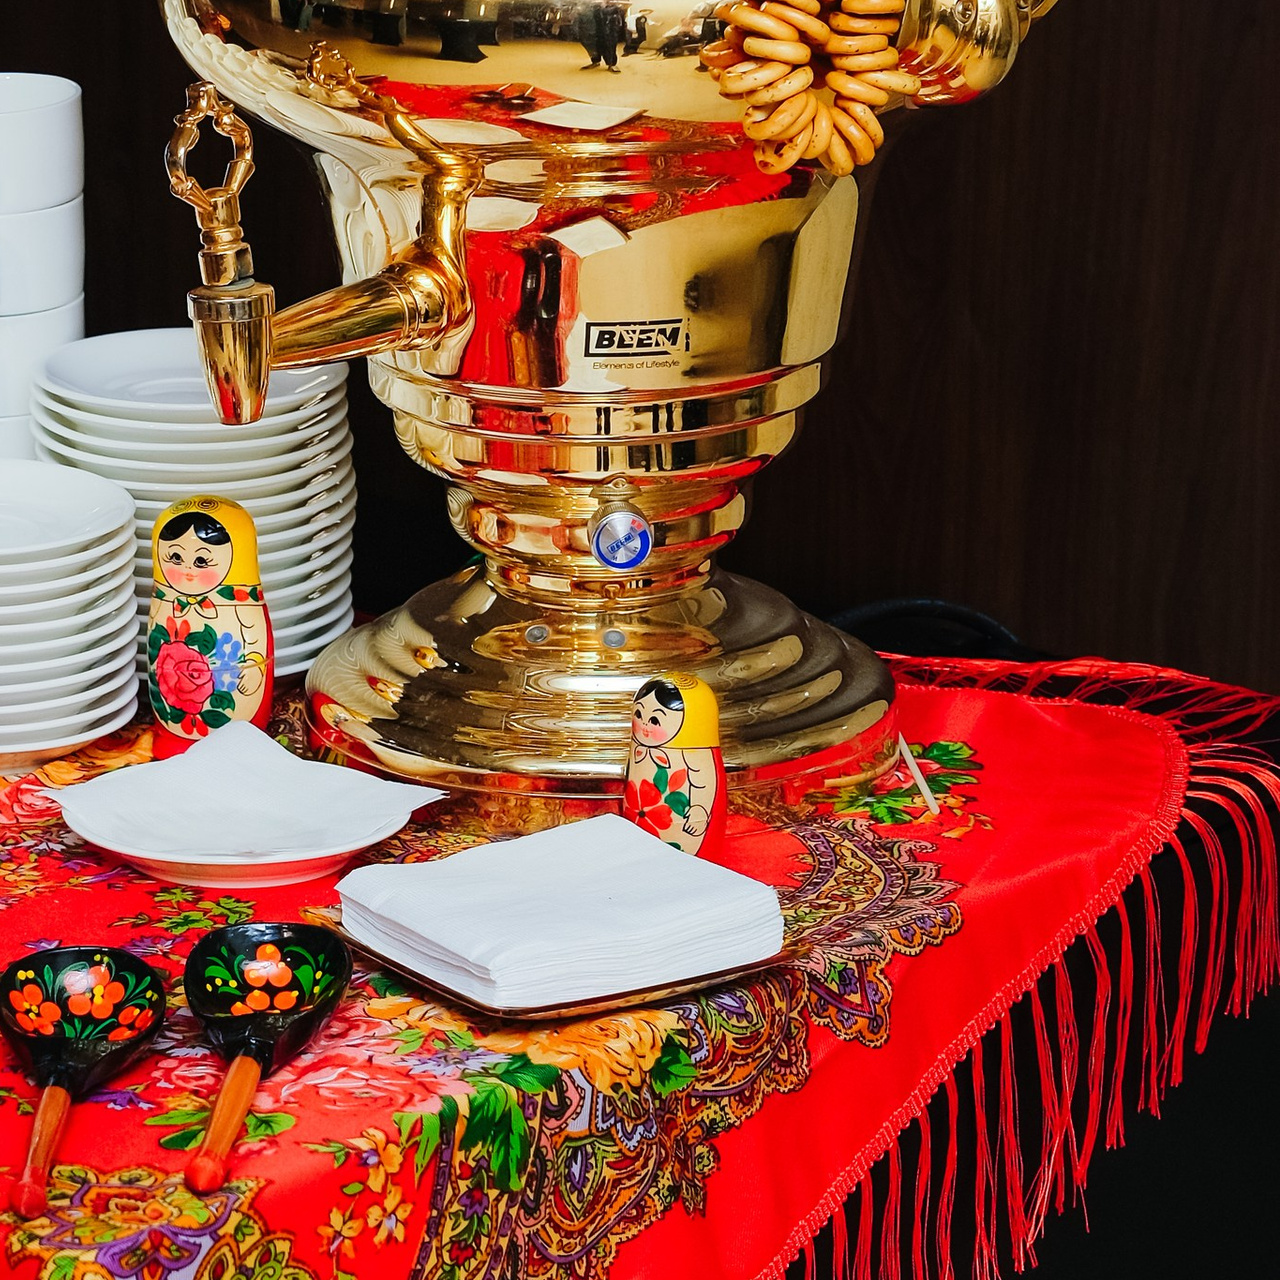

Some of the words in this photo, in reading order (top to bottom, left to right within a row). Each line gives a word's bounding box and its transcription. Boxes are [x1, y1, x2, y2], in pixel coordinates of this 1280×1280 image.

[595, 327, 680, 348] BEEM
[636, 360, 645, 369] of
[646, 359, 680, 368] Lifestyle
